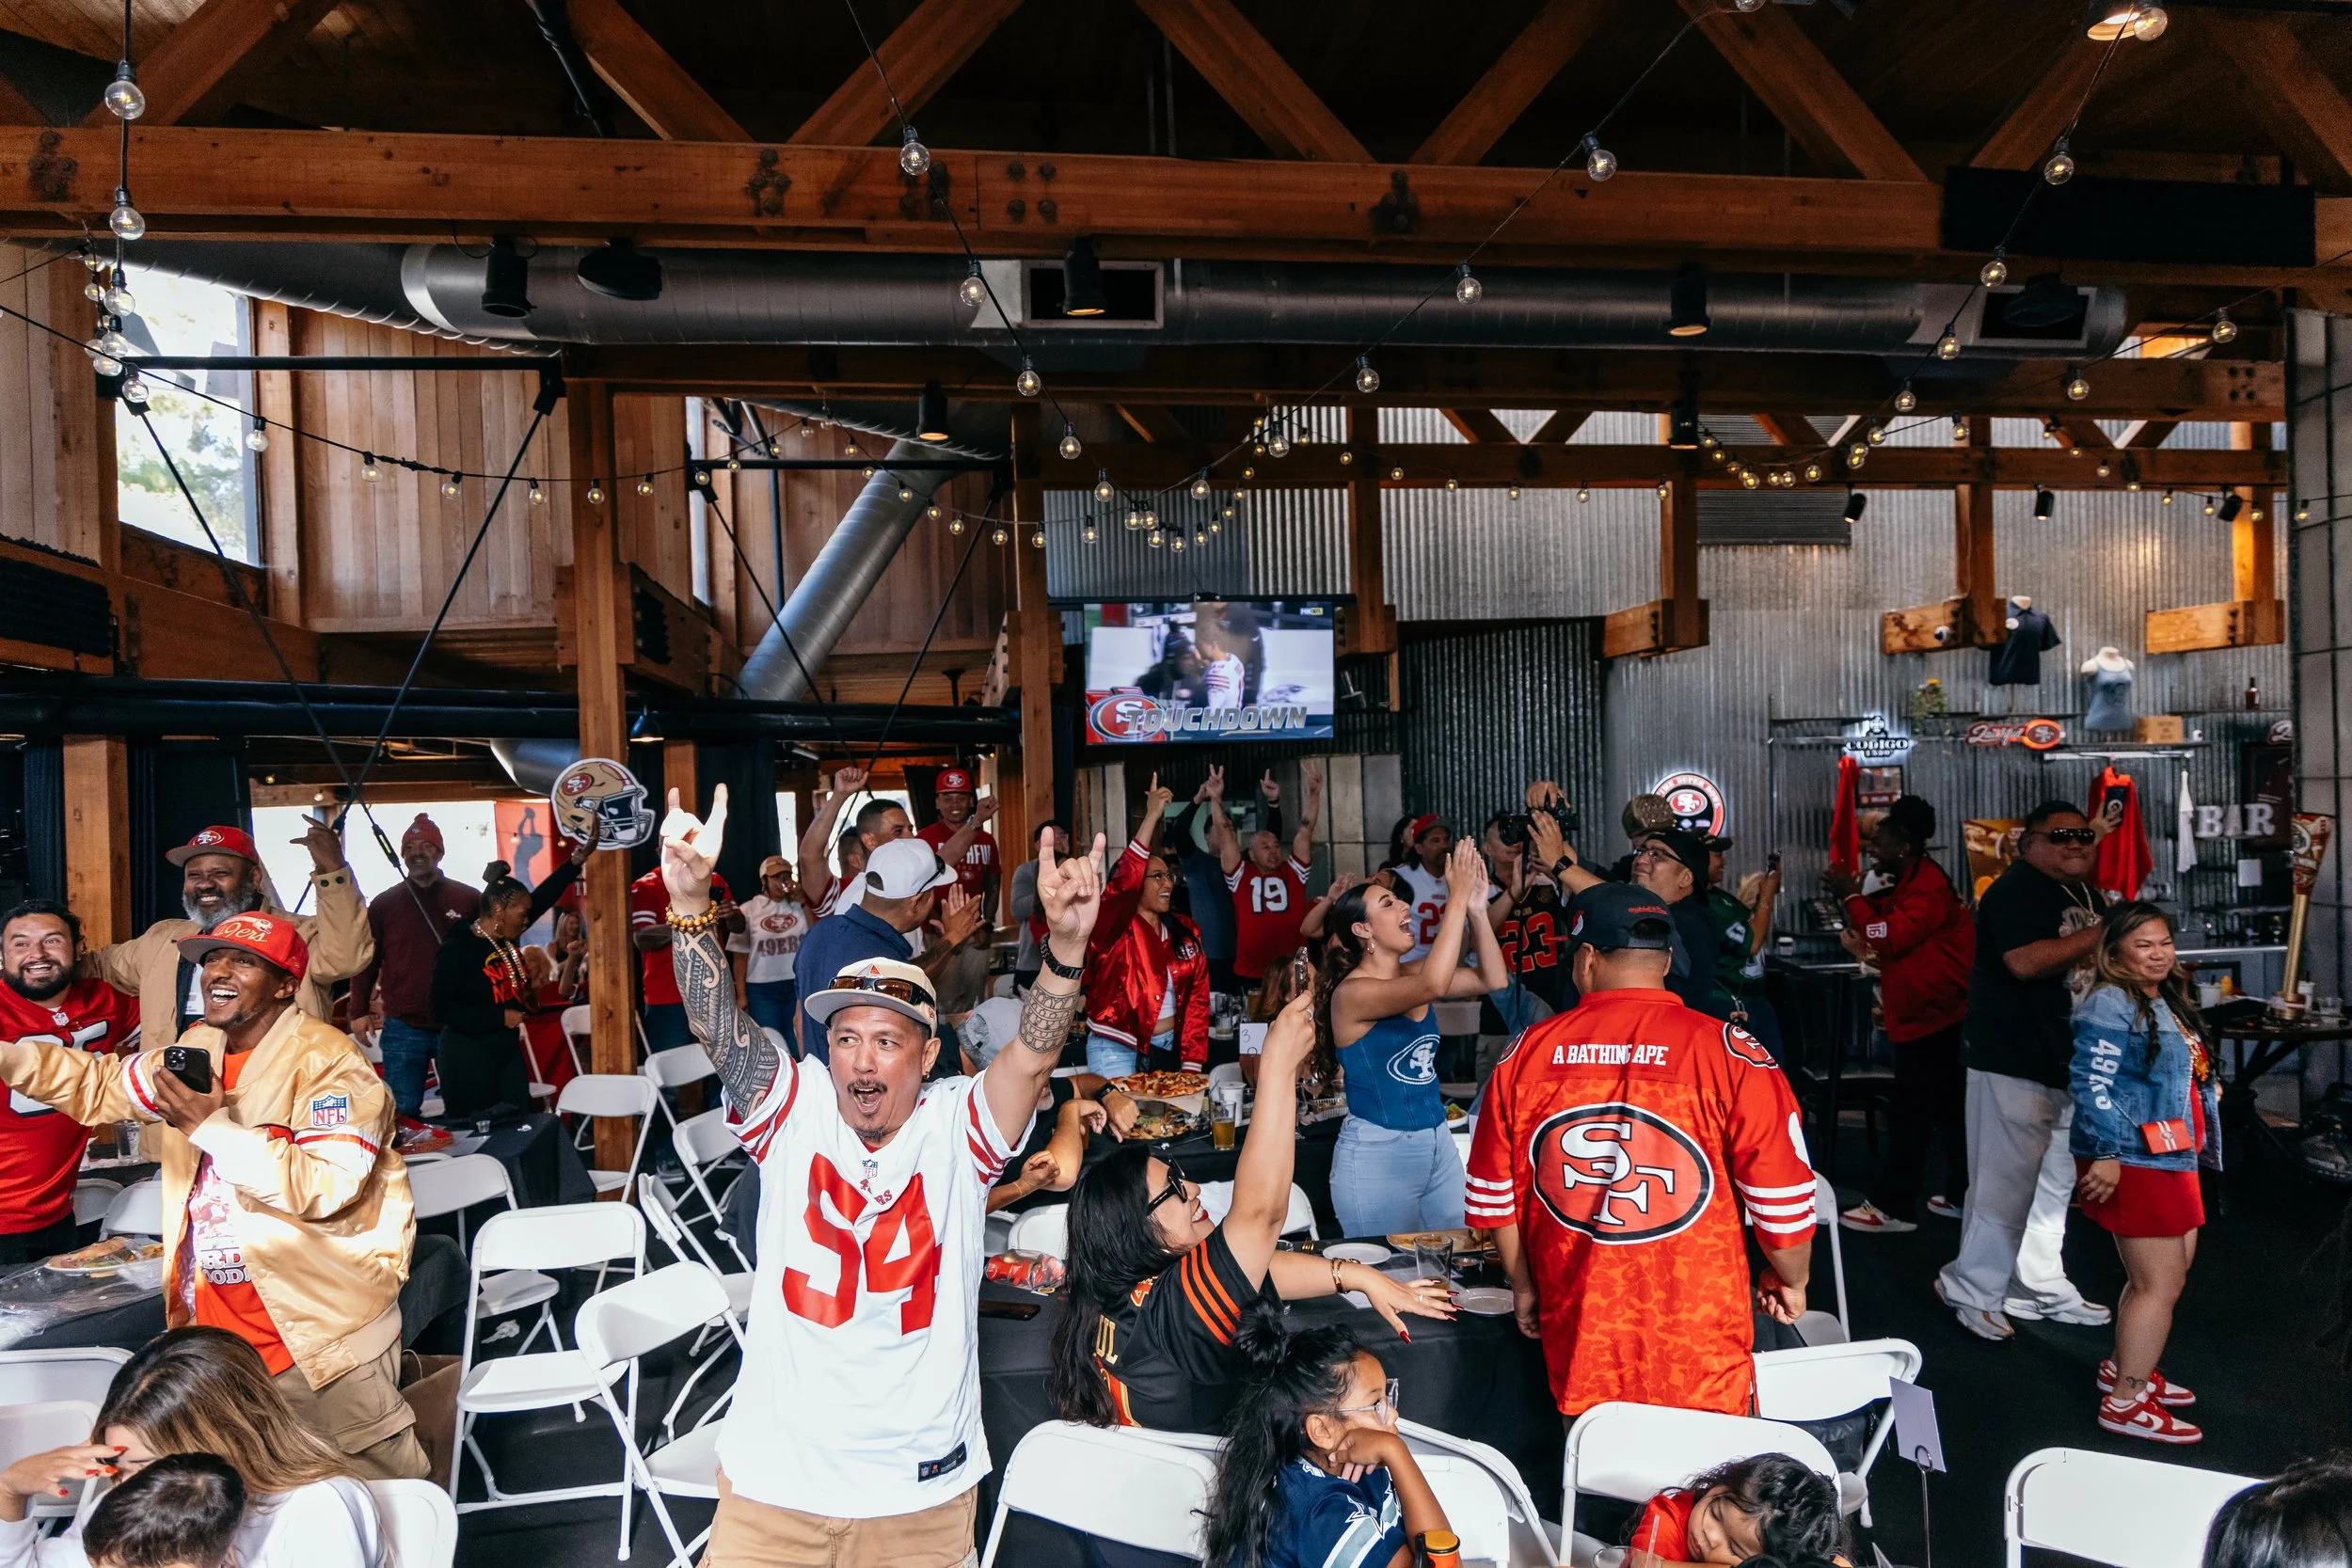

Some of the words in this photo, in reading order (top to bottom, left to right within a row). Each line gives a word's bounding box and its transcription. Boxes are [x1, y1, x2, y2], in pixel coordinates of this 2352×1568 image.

[1128, 706, 1308, 731] TOUCHDOWN
[2195, 803, 2276, 838] BAR
[1250, 876, 1288, 912] 19
[1418, 902, 1446, 944] 2
[1553, 1046, 1565, 1064] A
[1632, 1045, 1669, 1066] APE
[314, 1109, 345, 1125] NFL
[1560, 1121, 1676, 1227] SF
[782, 1152, 942, 1336] 54
